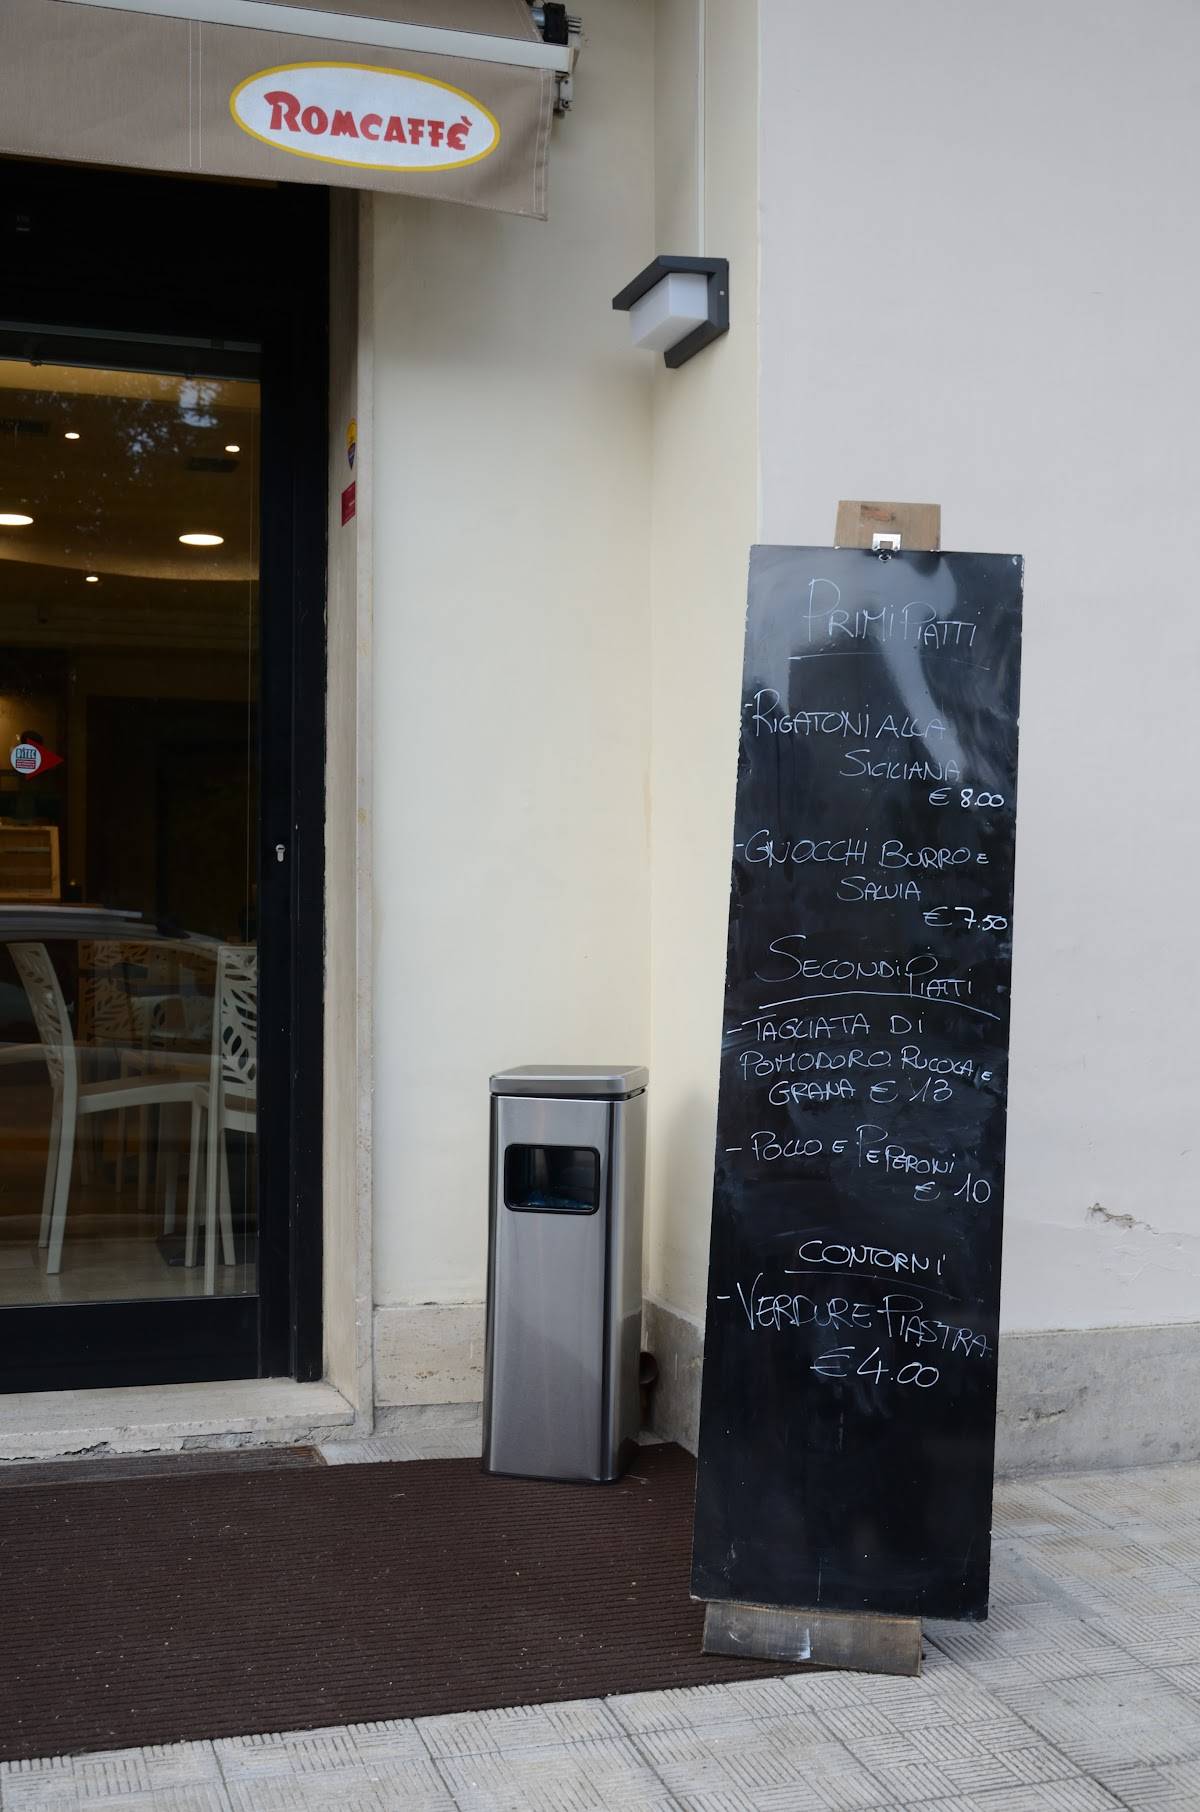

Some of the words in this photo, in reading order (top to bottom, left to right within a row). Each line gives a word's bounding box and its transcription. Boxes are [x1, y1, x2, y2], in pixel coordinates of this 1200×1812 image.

[960, 788, 1004, 807] 8.00
[768, 1080, 856, 1106] GRANA
[953, 1173, 992, 1204] 10
